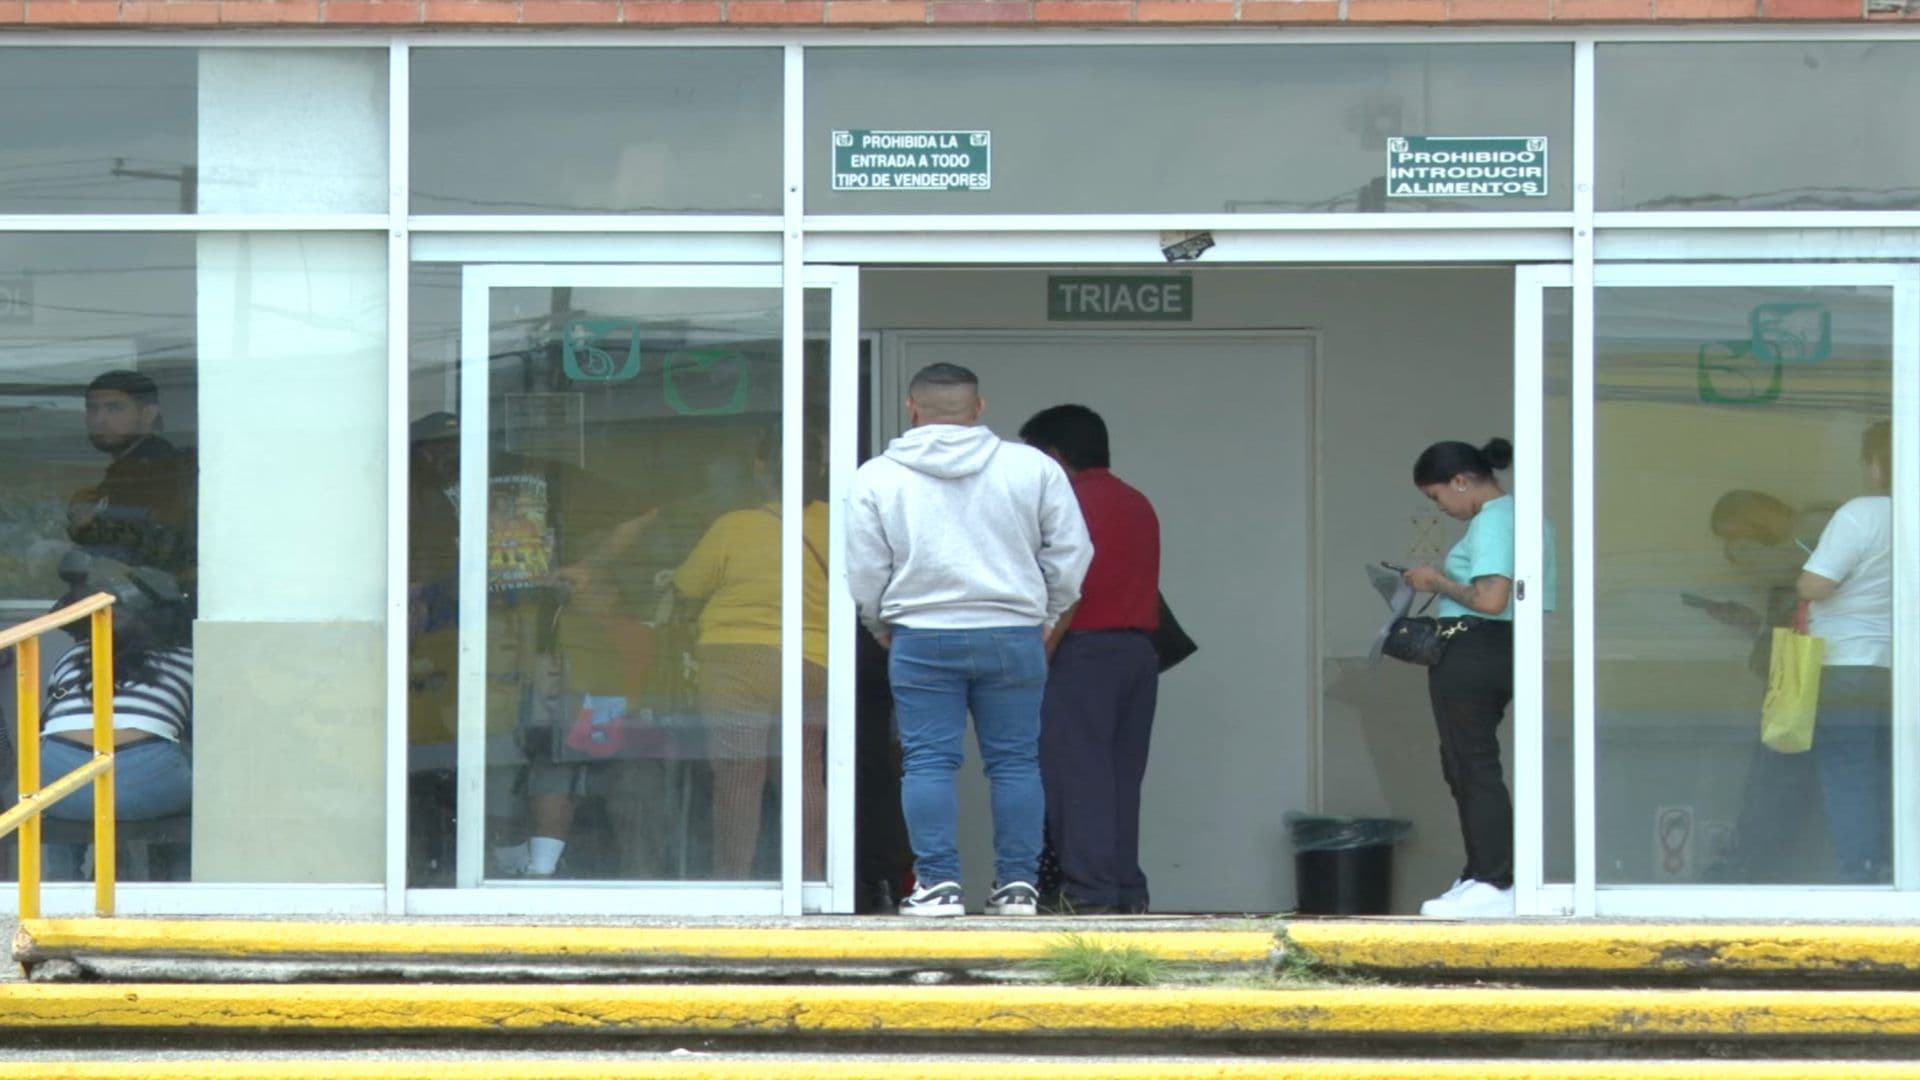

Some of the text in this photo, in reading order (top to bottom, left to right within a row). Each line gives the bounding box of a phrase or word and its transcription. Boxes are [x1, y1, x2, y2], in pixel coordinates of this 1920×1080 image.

[862, 135, 958, 149] PROHIBIDA LA
[851, 154, 970, 168] ENTRADA A TODO
[1398, 152, 1536, 164] PROHIBIDO
[1391, 166, 1542, 179] INTRODUCIR
[837, 173, 988, 187] TIPO DE VENDEDORES
[1395, 182, 1538, 194] ALIMENTOS
[1058, 283, 1182, 313] TRIAGE
